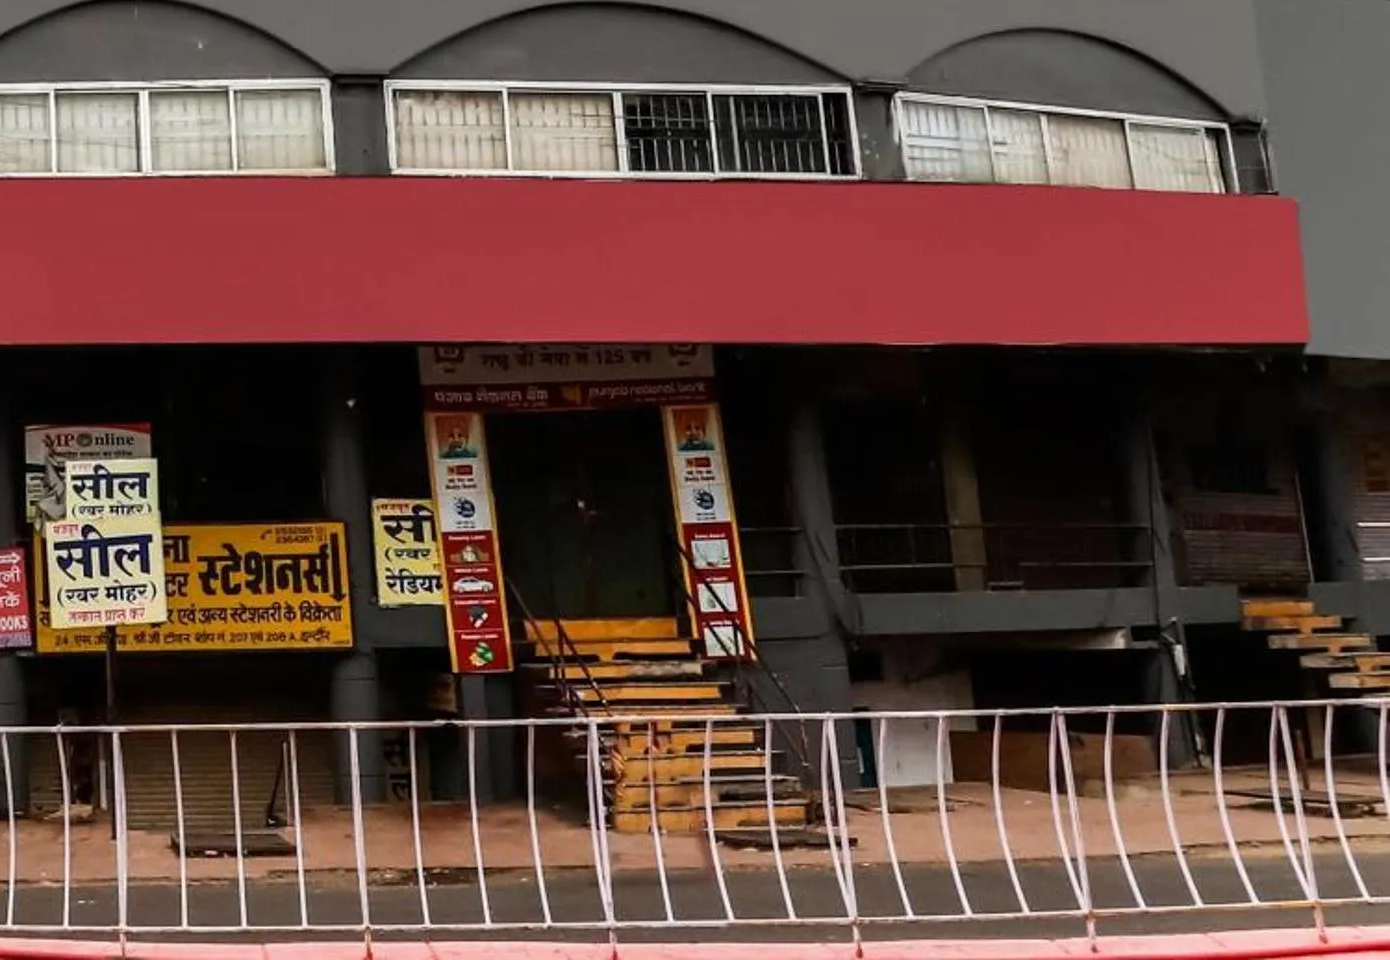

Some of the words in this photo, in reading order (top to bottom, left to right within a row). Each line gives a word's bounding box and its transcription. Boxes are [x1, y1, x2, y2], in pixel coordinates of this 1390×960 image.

[71, 464, 150, 501] सील
[380, 504, 436, 544] सी
[53, 524, 153, 581] सील
